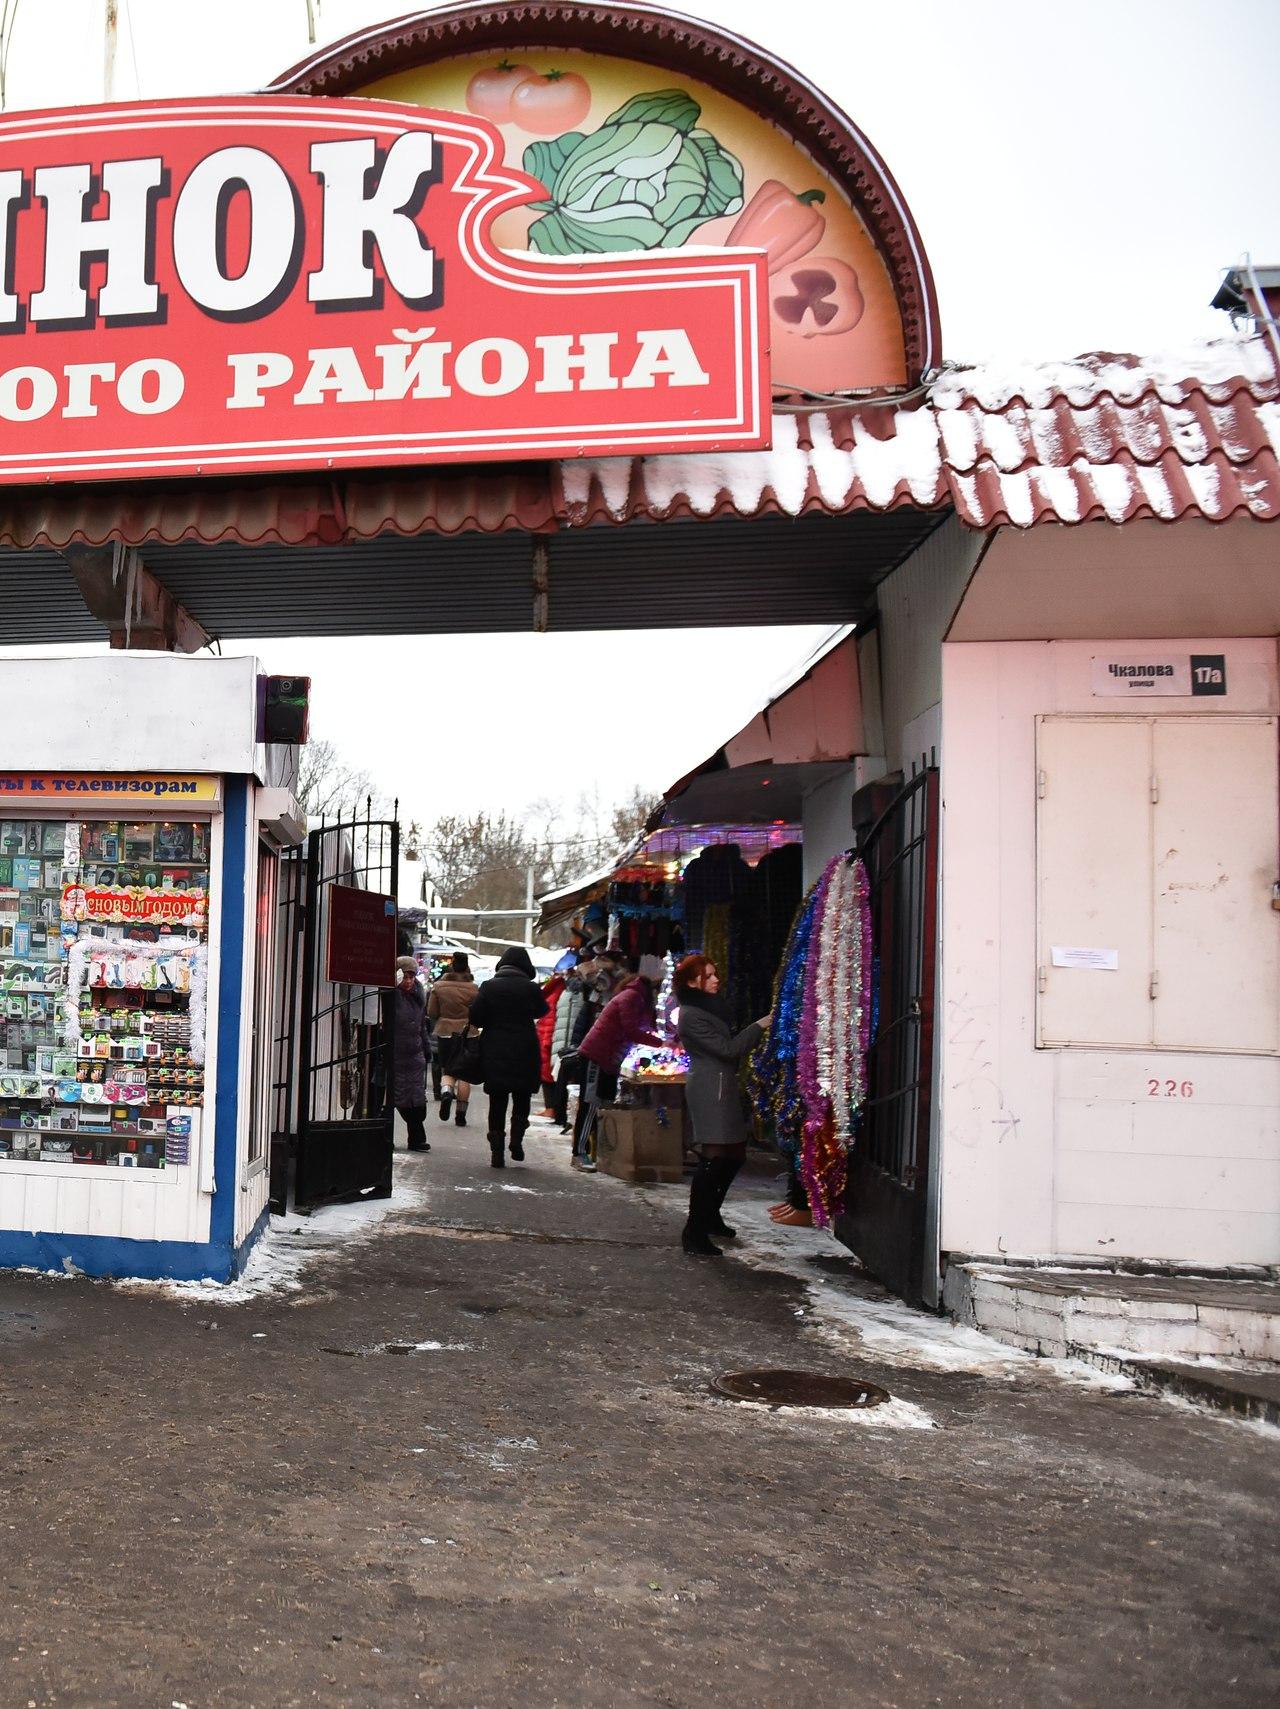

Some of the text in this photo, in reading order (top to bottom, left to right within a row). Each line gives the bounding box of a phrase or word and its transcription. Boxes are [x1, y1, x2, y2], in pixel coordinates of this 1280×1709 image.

[226, 326, 710, 406] РАЙОНА
[1108, 663, 1174, 677] Чкалова
[30, 779, 45, 790] к
[52, 779, 198, 795] телевизорам
[1148, 1079, 1193, 1097] 226
